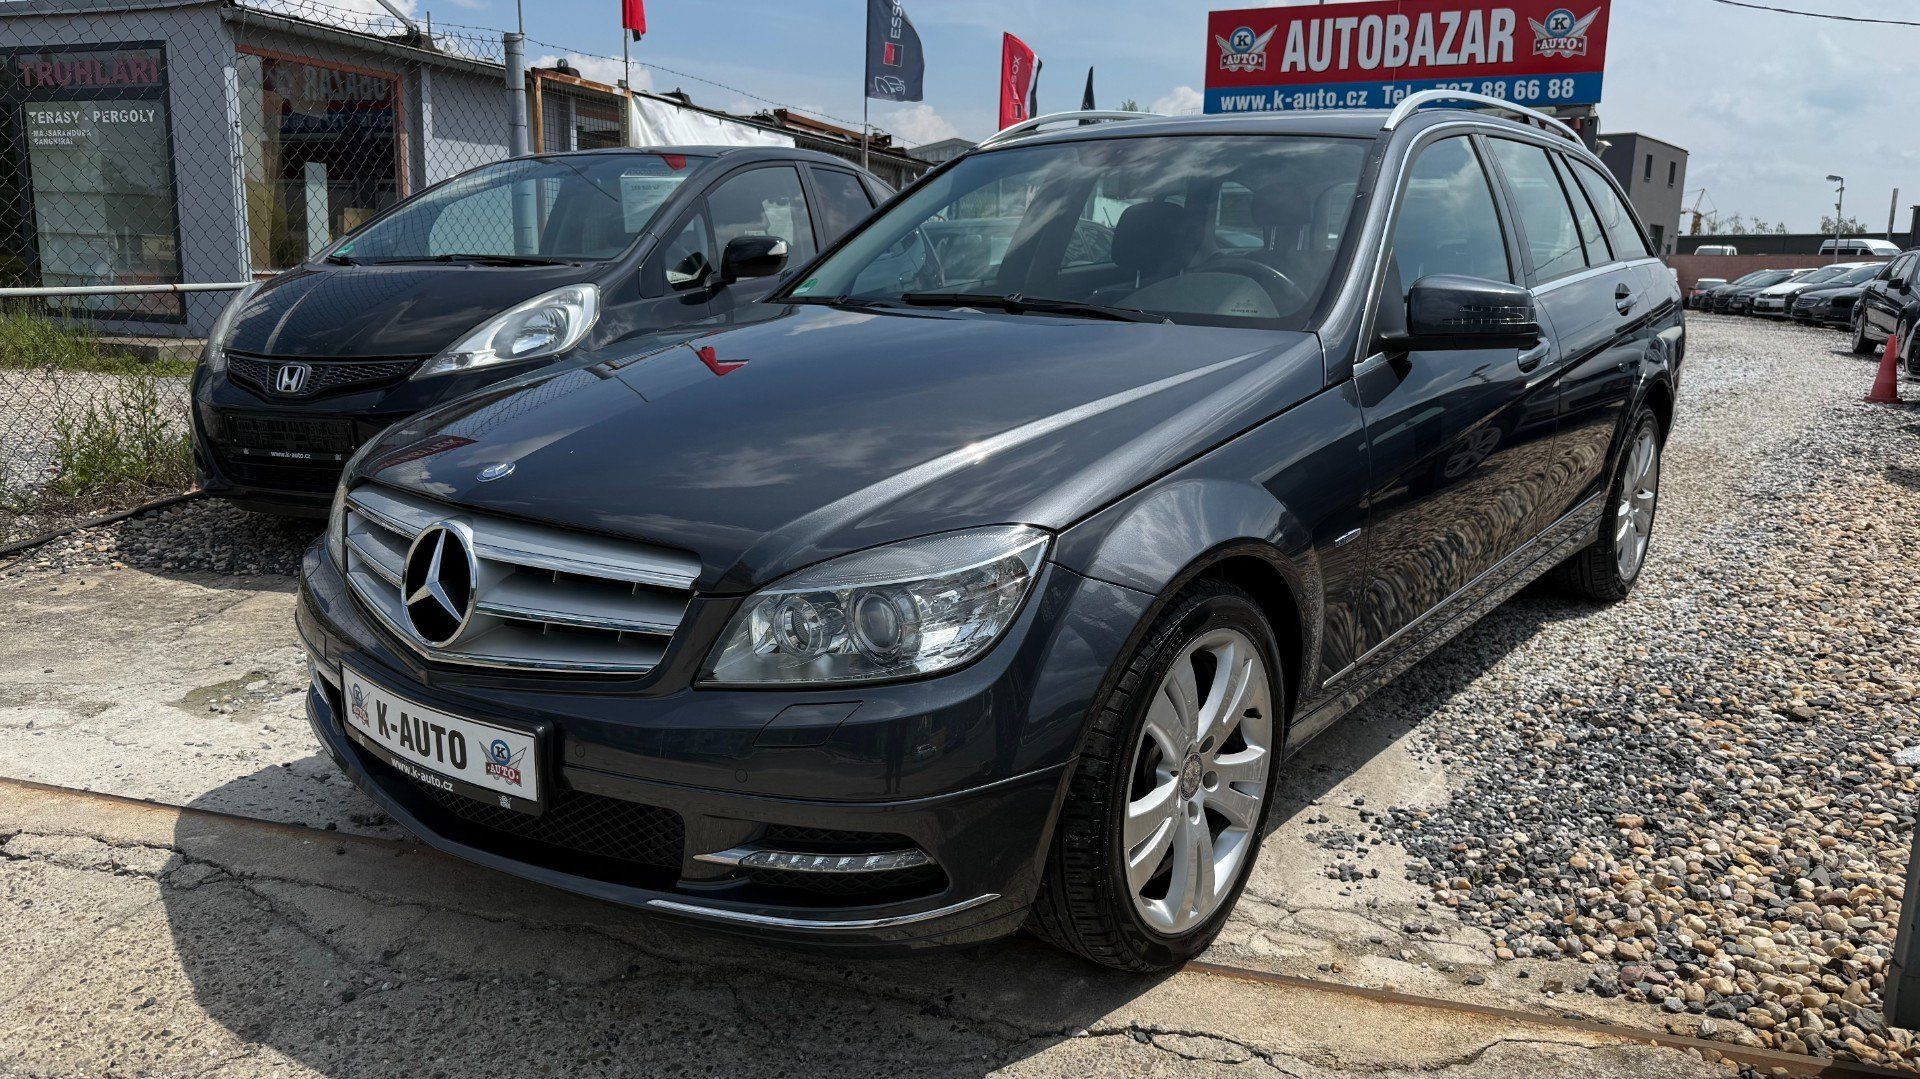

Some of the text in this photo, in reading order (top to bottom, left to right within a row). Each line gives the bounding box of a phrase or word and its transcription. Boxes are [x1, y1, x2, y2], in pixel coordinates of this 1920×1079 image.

[1552, 17, 1568, 31] K
[1236, 34, 1249, 47] K
[1281, 8, 1516, 72] AUTOBAZAR
[1540, 37, 1578, 50] AUTO
[1226, 54, 1258, 65] AUTO
[1221, 89, 1368, 111] www.k-auto.cz
[1481, 81, 1507, 100] 88
[1514, 79, 1540, 101] 66
[1548, 78, 1574, 99] 88
[29, 111, 80, 124] TERASY
[93, 110, 155, 123] PERGOLY
[376, 699, 468, 770] K-AUTO
[495, 746, 507, 760] K
[390, 757, 454, 792] www.k-auto.cz
[489, 764, 516, 780] AUTO
